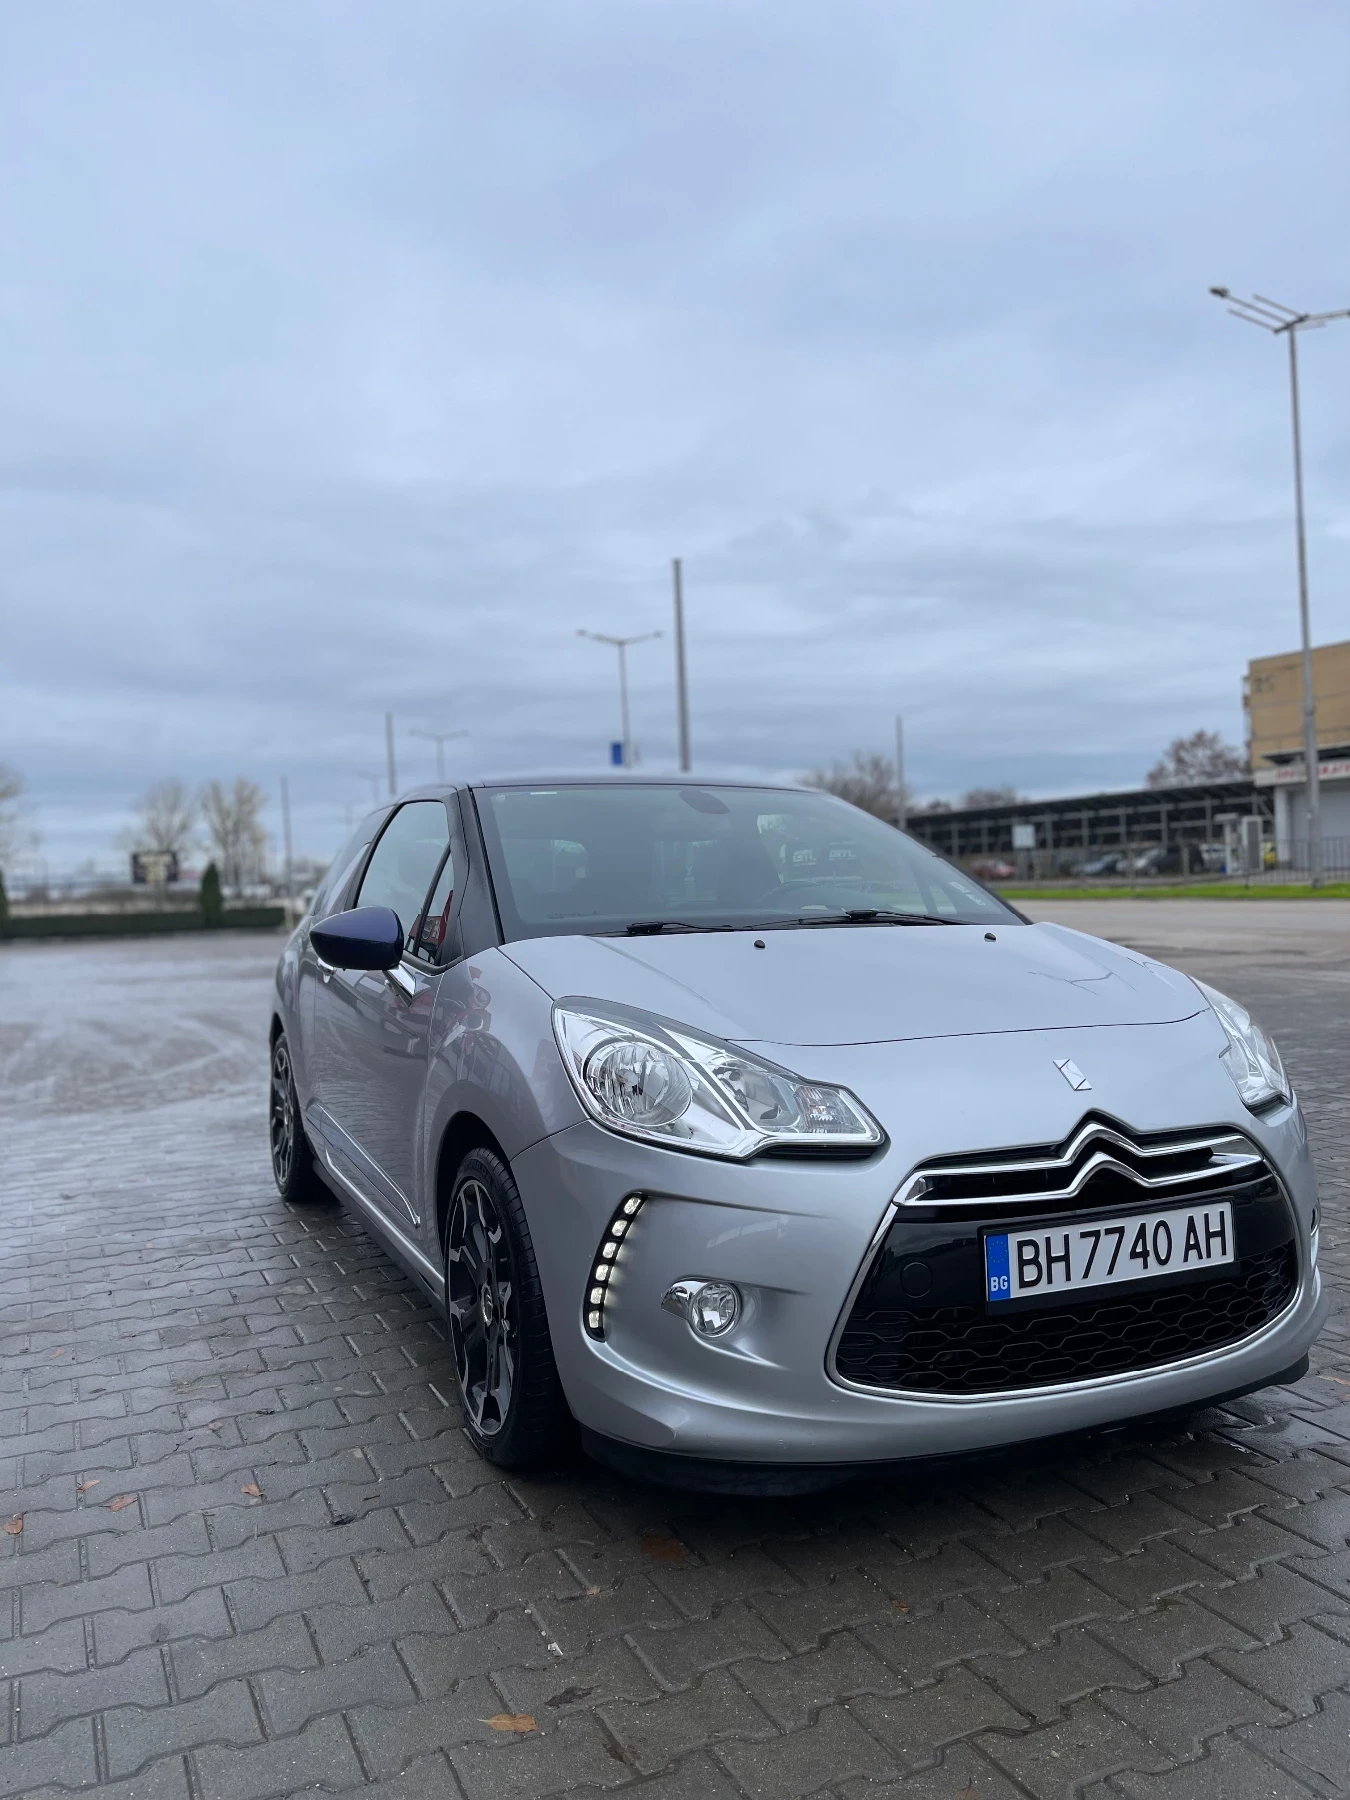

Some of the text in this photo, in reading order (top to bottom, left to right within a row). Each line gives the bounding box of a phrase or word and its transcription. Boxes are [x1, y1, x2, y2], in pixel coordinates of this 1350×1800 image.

[1016, 1210, 1227, 1289] BH 7740 AH
[990, 1275, 1008, 1292] BG
